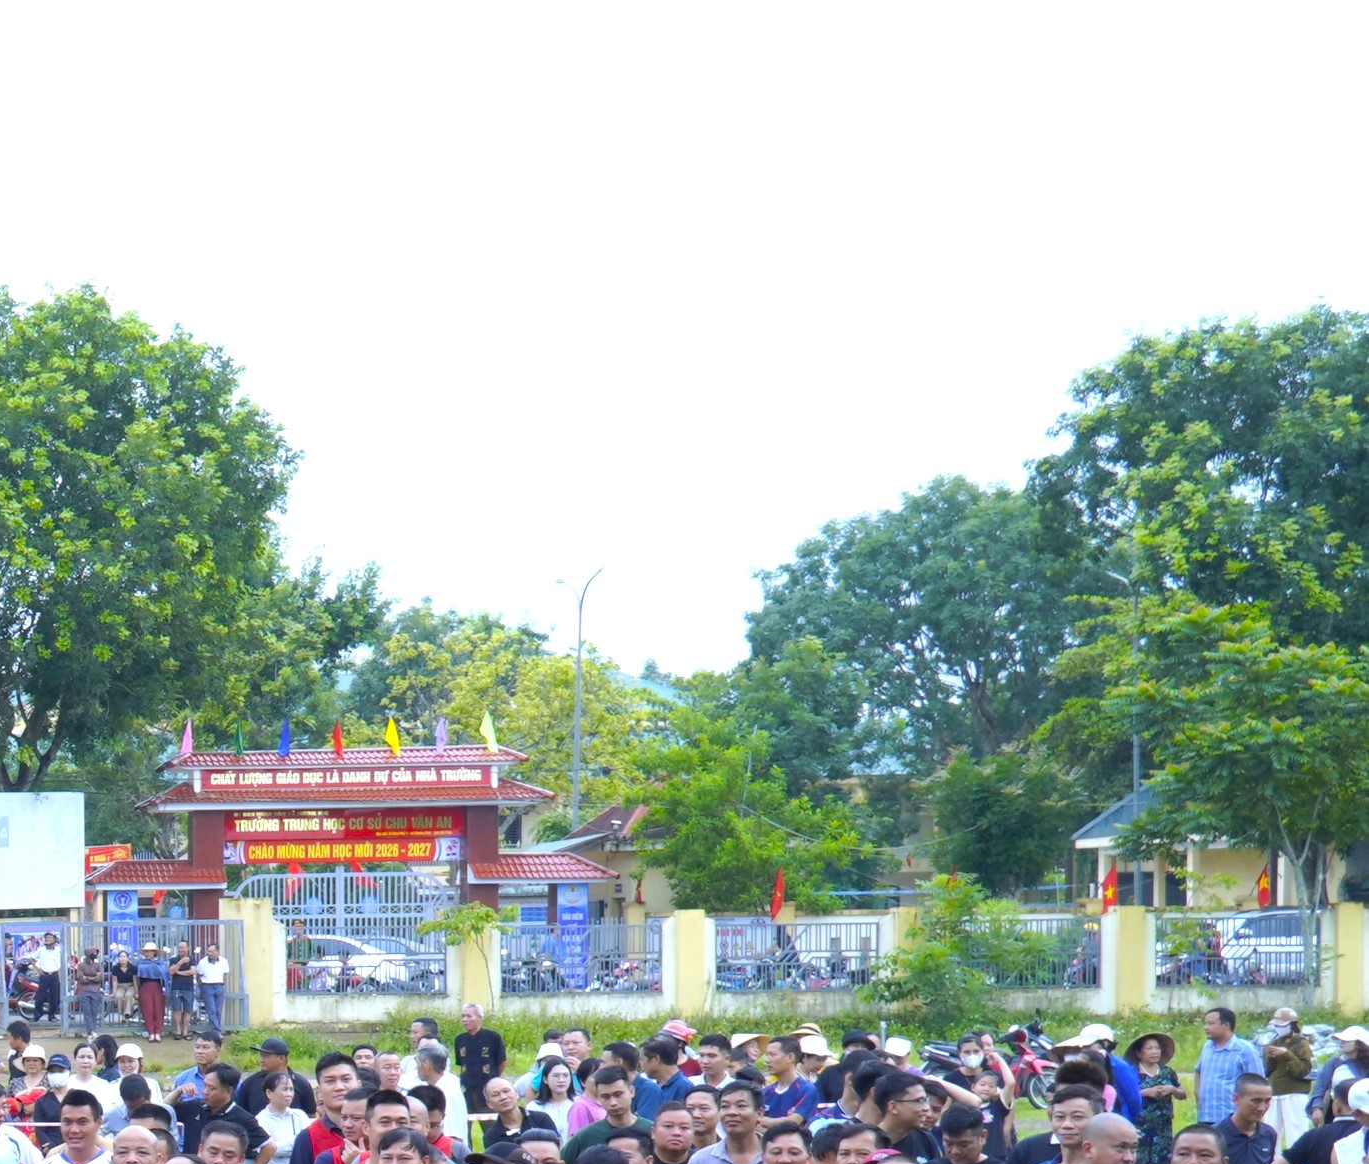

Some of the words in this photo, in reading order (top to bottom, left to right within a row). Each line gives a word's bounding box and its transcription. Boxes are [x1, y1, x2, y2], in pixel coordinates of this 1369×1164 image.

[327, 769, 339, 783] LÀ
[392, 768, 412, 782] CỦA
[234, 817, 279, 832] TRƯỜNG
[283, 818, 319, 832] TRUNG
[323, 819, 345, 834] HỌC
[349, 818, 363, 830] CƠ
[386, 817, 407, 828] CHU
[436, 816, 452, 828] AN
[249, 844, 275, 859] CHÀO
[277, 843, 305, 858] MỪNG
[308, 843, 330, 857] NĂM
[333, 845, 352, 860] HỌC
[355, 843, 374, 856] MỚI
[376, 843, 399, 856] 2026
[408, 843, 431, 856] 2027
